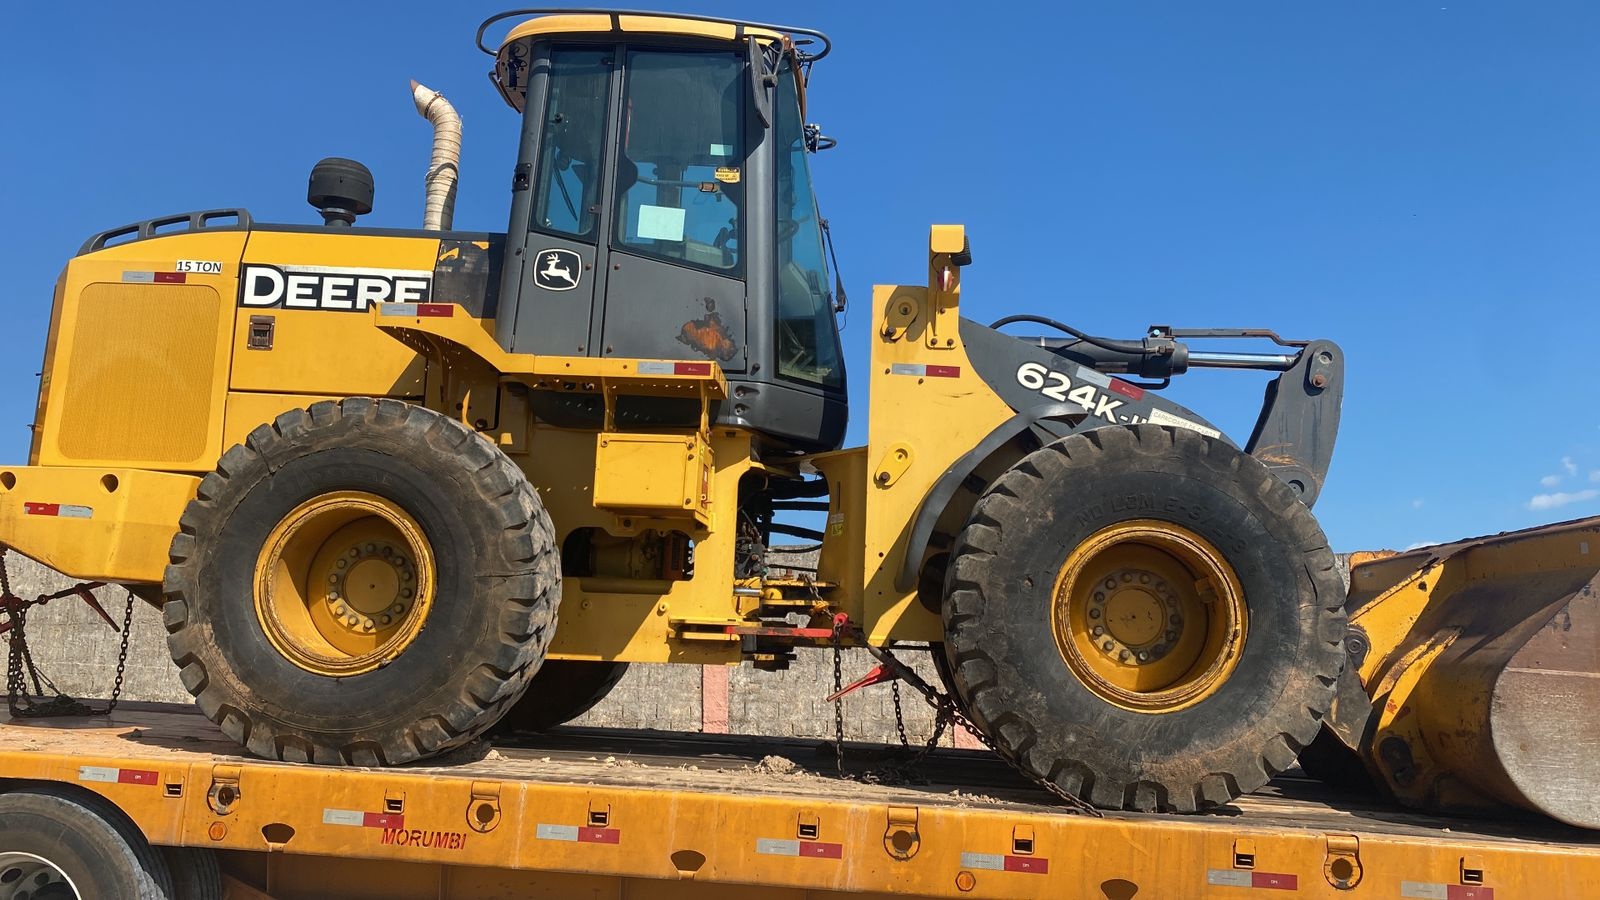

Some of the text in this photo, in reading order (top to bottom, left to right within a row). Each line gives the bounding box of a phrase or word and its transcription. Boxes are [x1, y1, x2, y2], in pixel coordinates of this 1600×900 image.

[177, 261, 222, 272] 15 TON
[243, 266, 427, 309] DEERE
[1016, 362, 1148, 424] 624K-
[381, 828, 467, 850] MORUMBI
